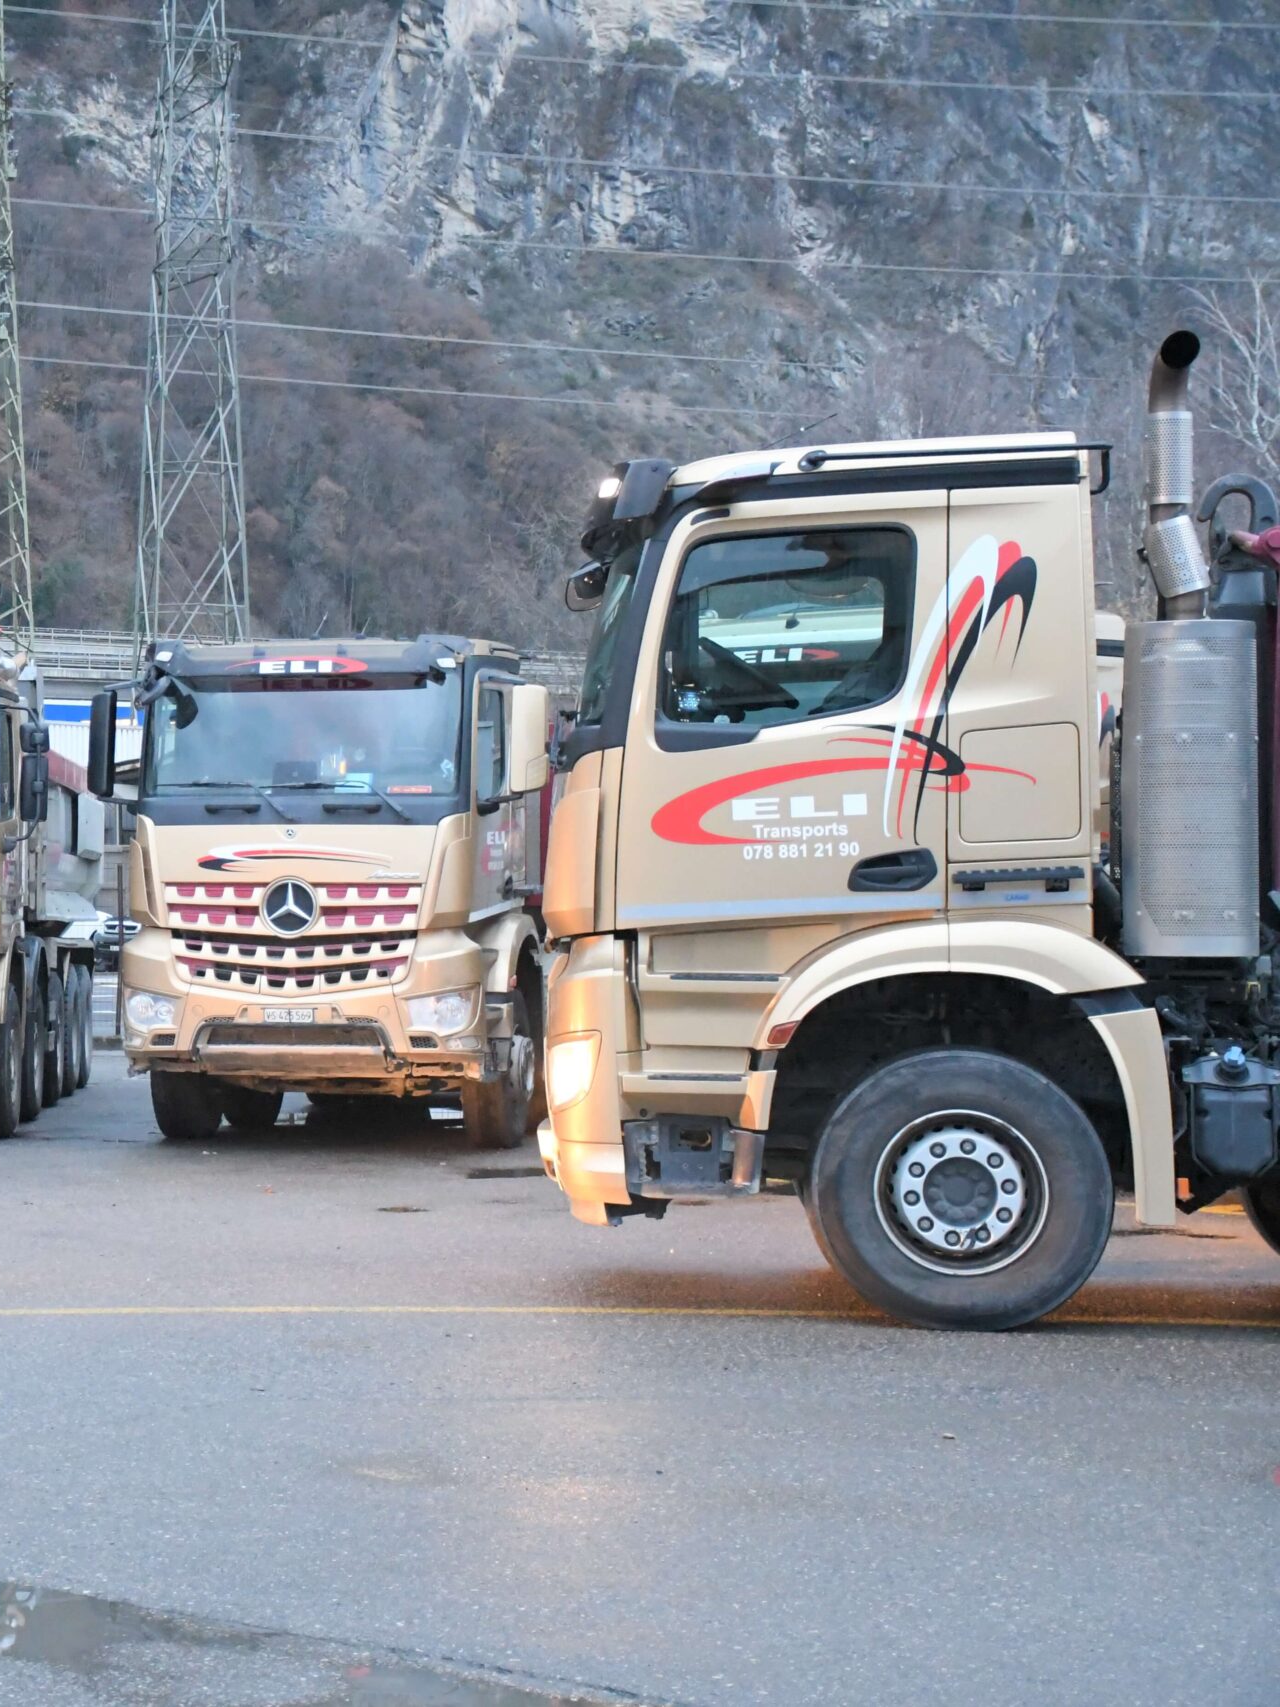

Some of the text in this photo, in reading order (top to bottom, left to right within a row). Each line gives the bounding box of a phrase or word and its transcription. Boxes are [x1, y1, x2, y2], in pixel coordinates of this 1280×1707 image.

[734, 648, 803, 663] ELI
[259, 660, 333, 674] ELI
[732, 793, 868, 821] ELI
[752, 822, 848, 840] Transports
[742, 841, 860, 860] 078 881 21 90
